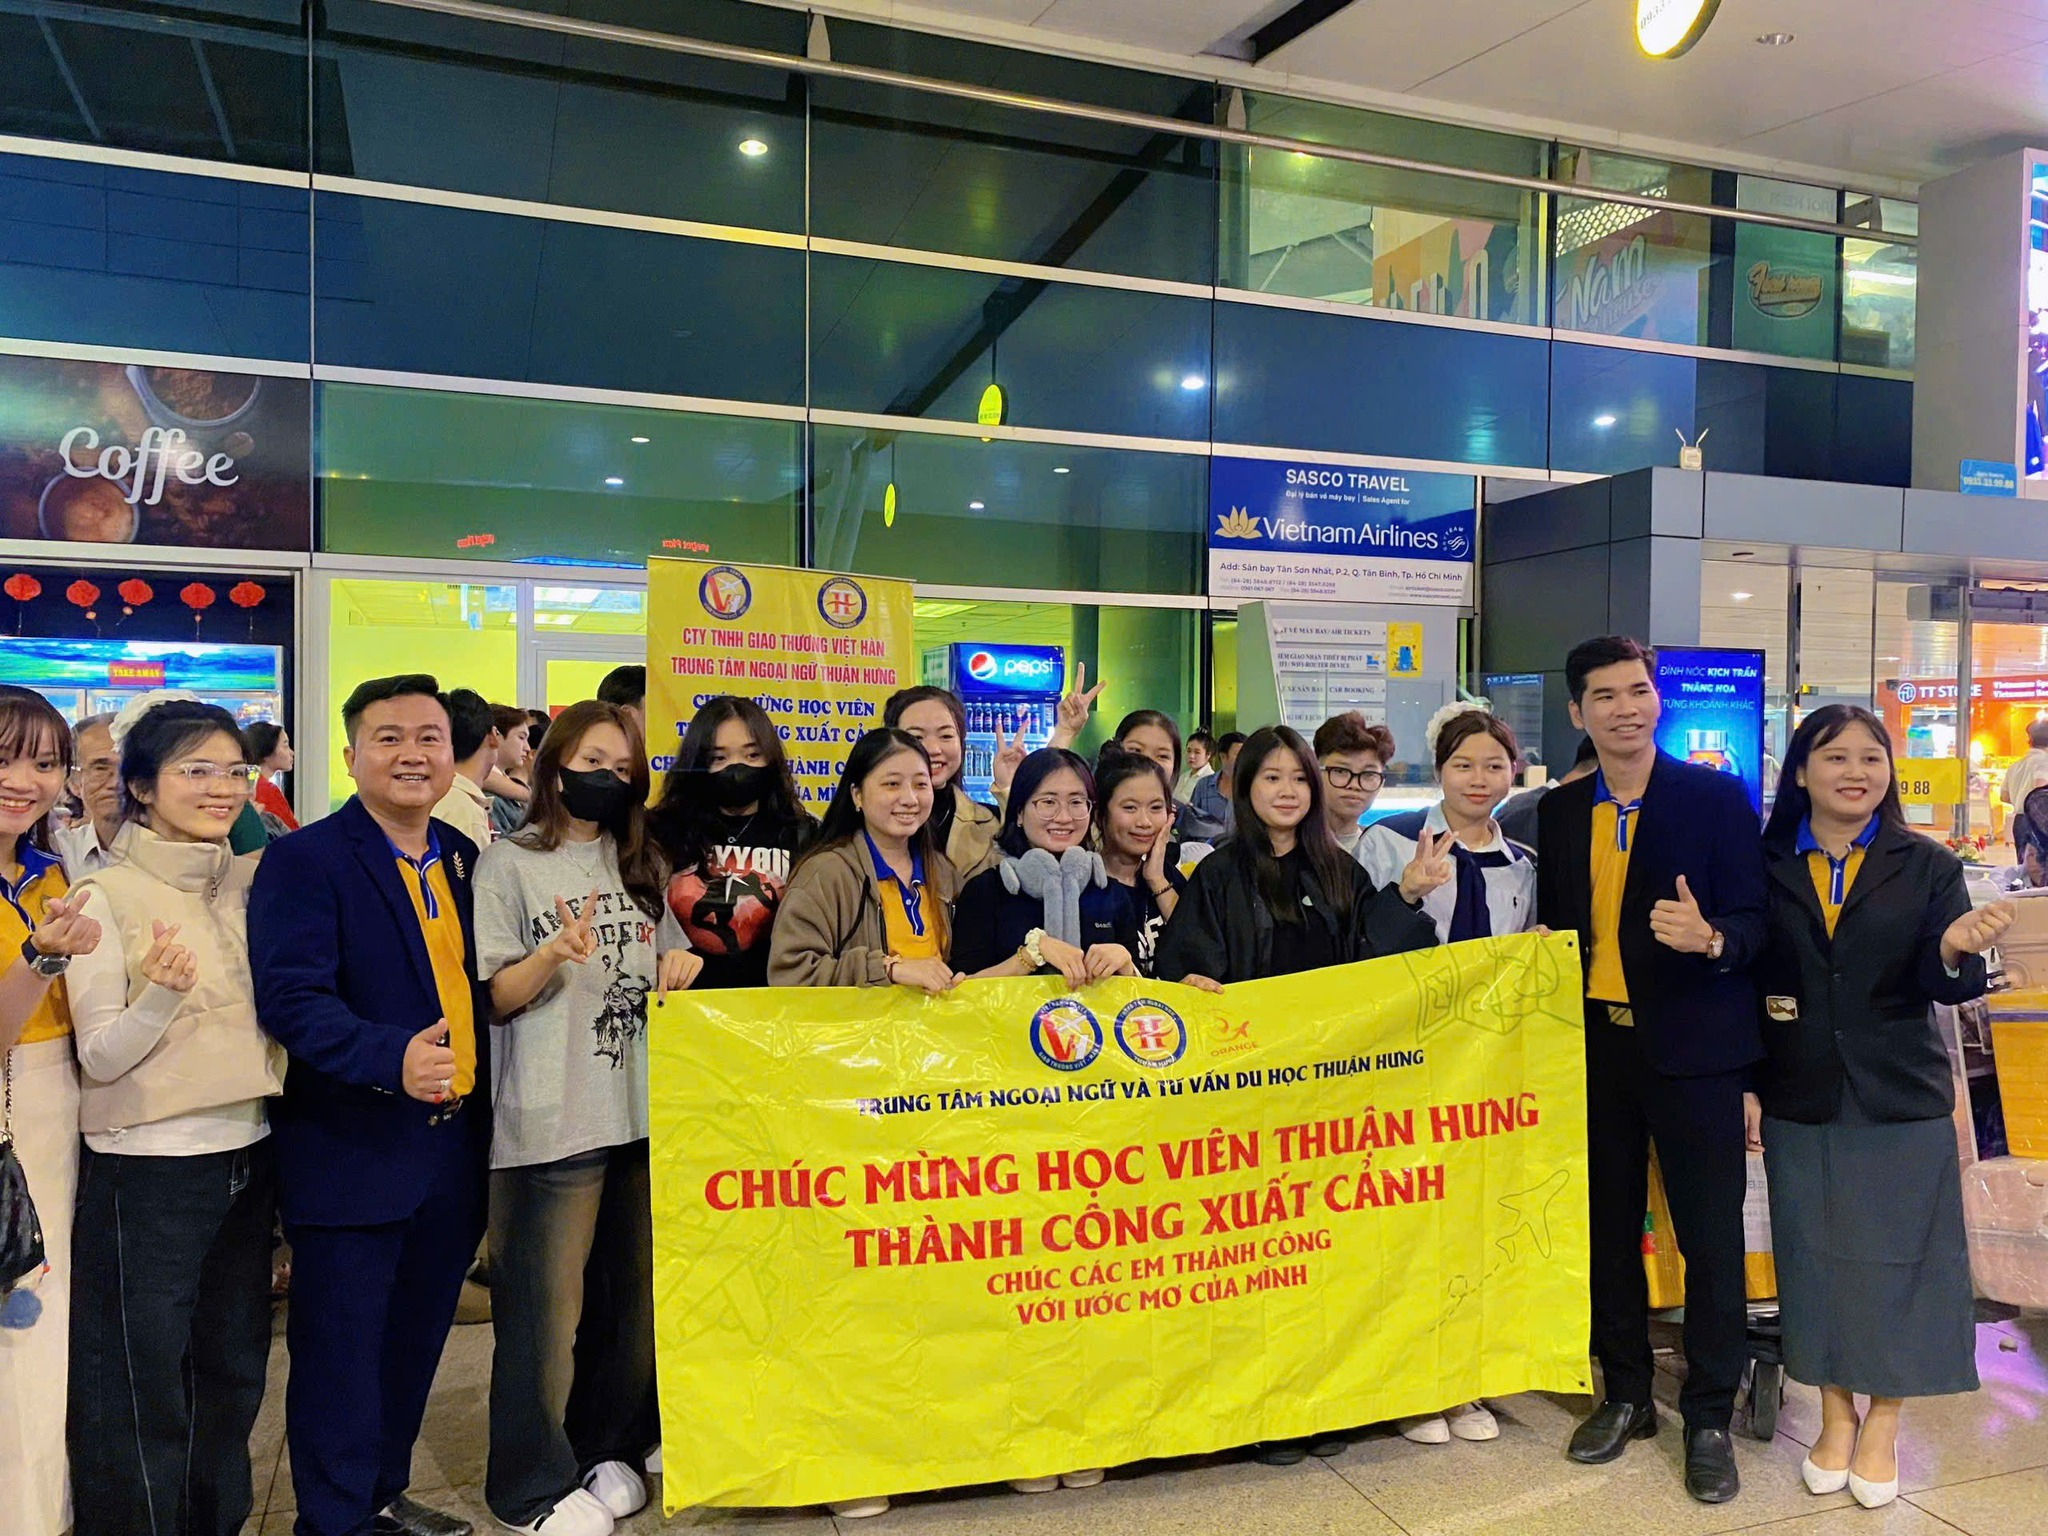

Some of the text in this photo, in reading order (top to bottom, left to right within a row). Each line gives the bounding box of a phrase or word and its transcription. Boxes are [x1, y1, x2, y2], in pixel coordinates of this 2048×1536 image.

[59, 427, 239, 505] Coffee
[1286, 468, 1411, 493] SASCO TRAVEL
[1263, 517, 1439, 550] Vietnam Airlines
[1220, 562, 1240, 571] Add:
[1260, 563, 1275, 574] bay
[682, 627, 885, 659] CTY TNHH GIAO THƯƠNG VIỆT HÀN
[671, 656, 896, 687] TRUNG TÂM NGOẠI NGỮ THUẬN HƯNG
[1004, 656, 1054, 677] pepsi
[1715, 683, 1736, 693] HOA
[1919, 686, 1936, 698] TT
[798, 700, 831, 719] HỌC
[836, 697, 875, 717] VIÊN
[795, 720, 841, 743] XUẤT
[788, 757, 830, 776] HÀNH
[1900, 781, 1930, 795] 9.88
[1210, 1041, 1258, 1057] ORANGE
[856, 1094, 931, 1117] TRUNG
[937, 1088, 983, 1110] TÂM
[990, 1087, 1061, 1111] NGOẠI
[1067, 1078, 1116, 1102] NGỮ
[1120, 1077, 1151, 1099] VÀ
[1189, 1068, 1230, 1094] VẤN
[1236, 1070, 1262, 1089] DU
[1268, 1065, 1308, 1087] HỌC
[1313, 1054, 1371, 1079] THUẬN
[1375, 1049, 1424, 1070] HƯNG
[704, 1092, 1540, 1211] CHÚC MỪNG HỌC VIÊN THUẬN HƯNG
[844, 1158, 1446, 1269] THÀNH CÔNG XUẤT CẢNH
[986, 1229, 1332, 1296] CHÚC CÁC EM THÀNH CÔNG
[1016, 1263, 1308, 1325] VỚI ƯỚC MƠ CỦA MÌNH
